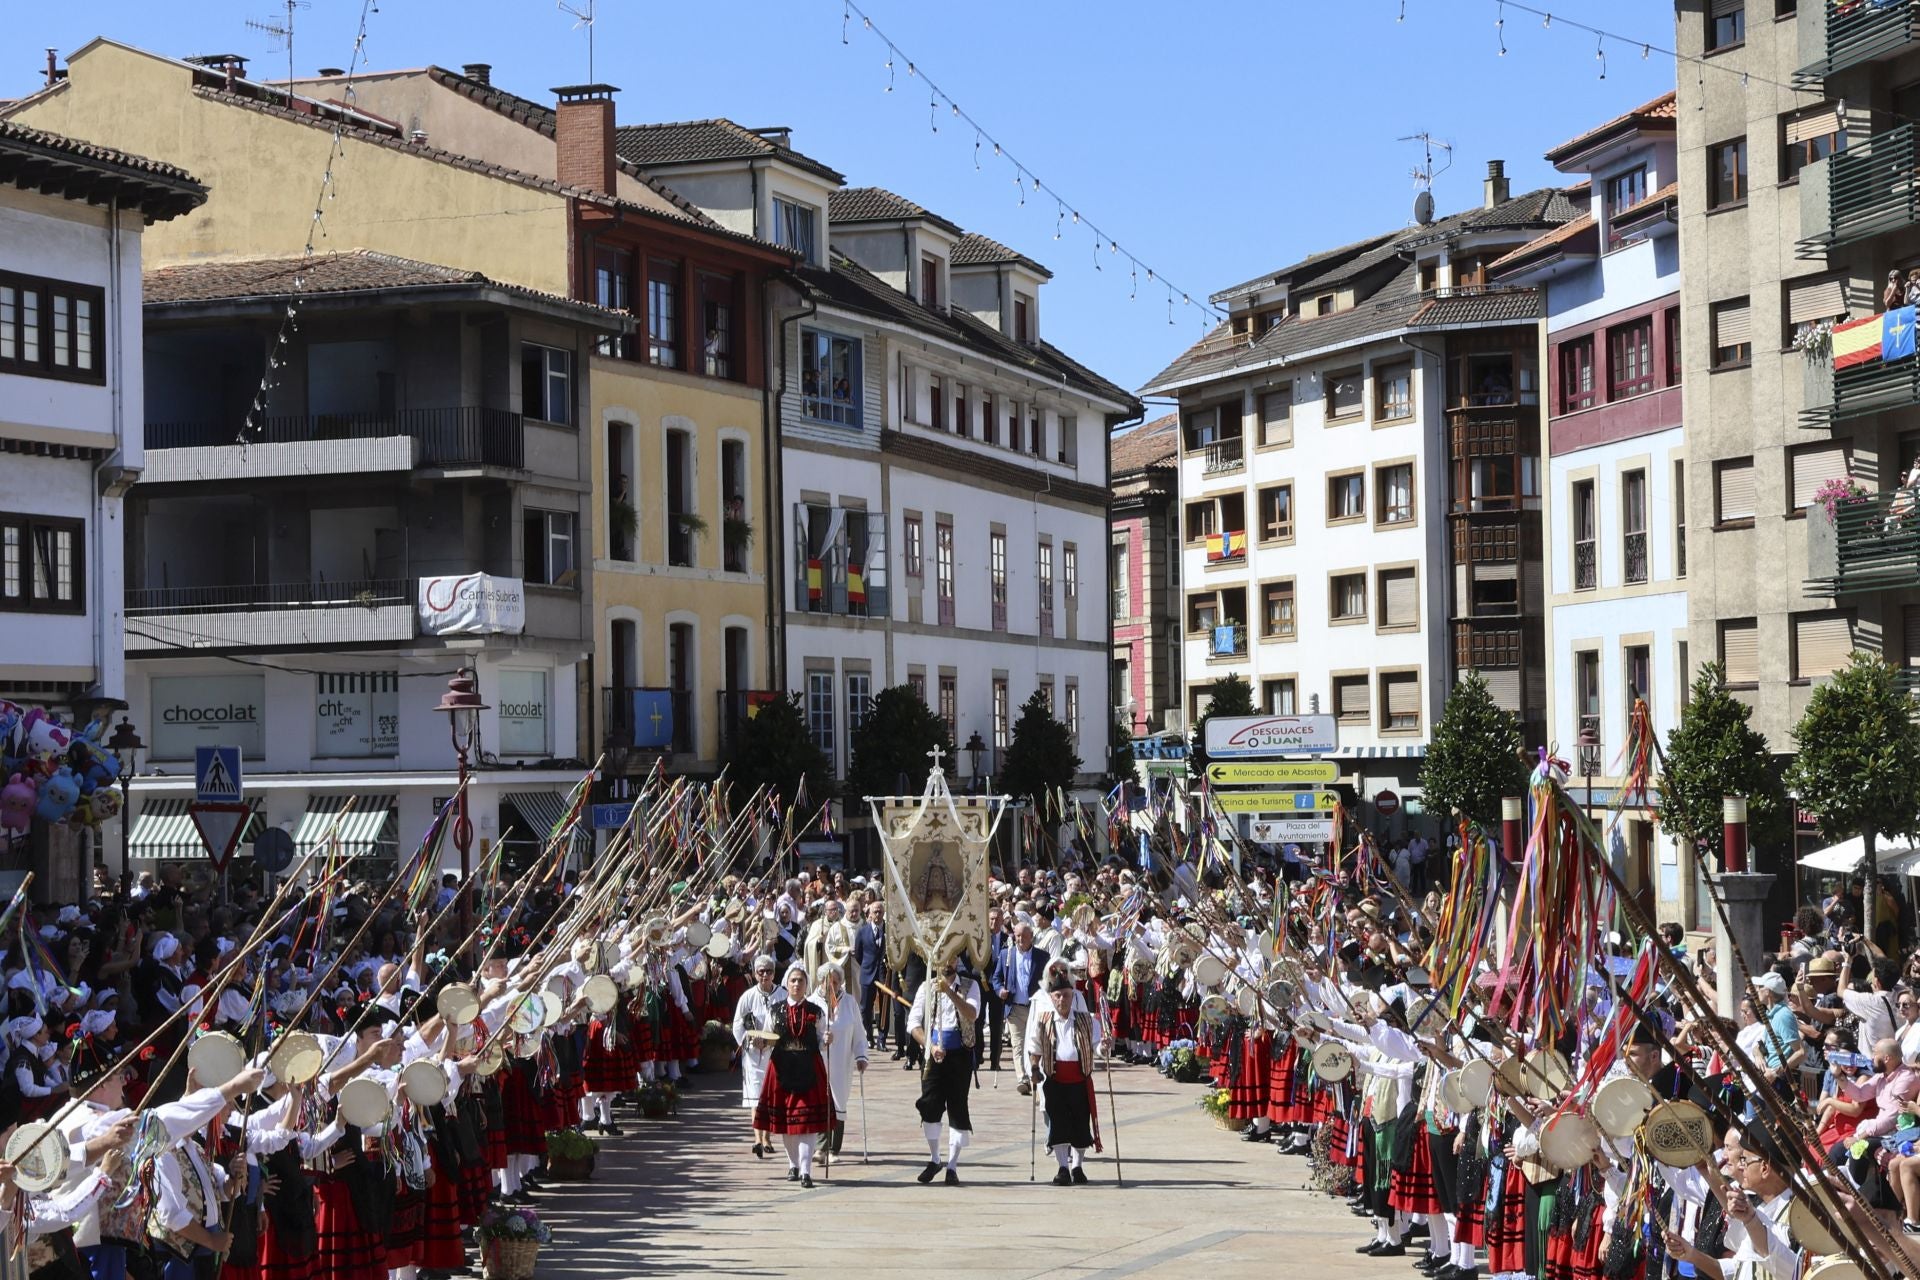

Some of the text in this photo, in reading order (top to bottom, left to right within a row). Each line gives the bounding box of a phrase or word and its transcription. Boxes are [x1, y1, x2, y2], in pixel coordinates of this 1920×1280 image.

[163, 704, 257, 721] chocolat
[318, 699, 344, 717] cht
[498, 699, 543, 716] hocolat
[1252, 726, 1314, 736] DESGUACES
[1263, 735, 1302, 745] JUAN
[1233, 768, 1327, 777] Mercado de Abastos
[1247, 797, 1259, 806] de
[1307, 822, 1320, 830] del
[1278, 832, 1329, 841] Ayuntamiento
